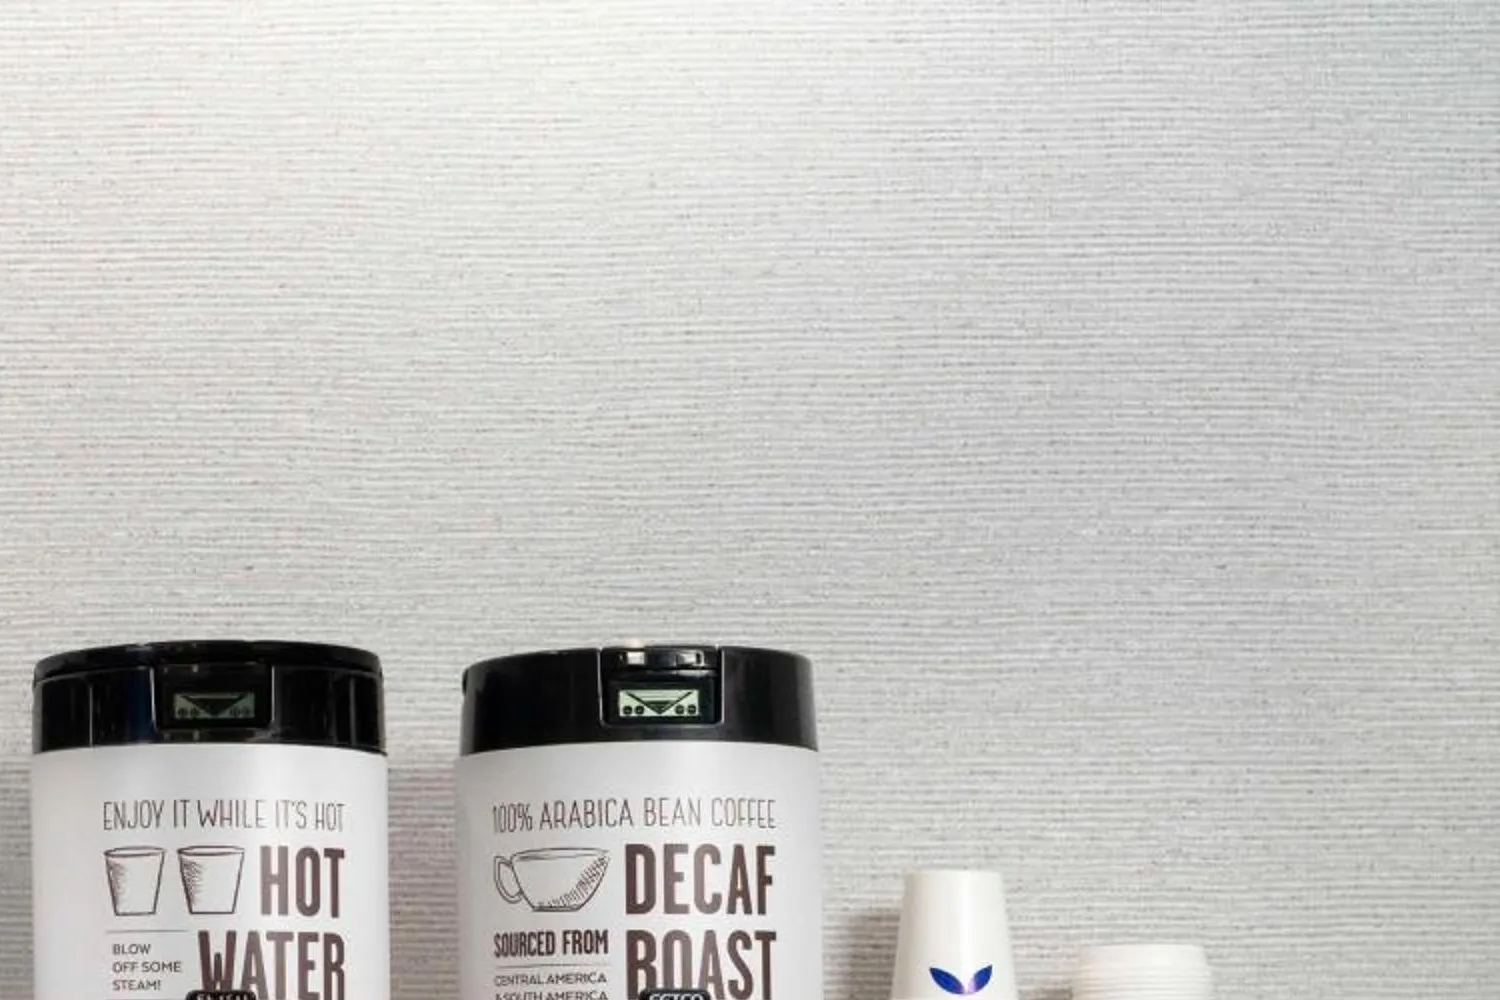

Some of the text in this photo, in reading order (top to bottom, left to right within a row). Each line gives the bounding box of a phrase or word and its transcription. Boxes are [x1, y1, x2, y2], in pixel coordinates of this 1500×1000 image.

[103, 800, 345, 831] ENJOY IT WHILE IT'S HOT
[493, 797, 776, 832] 100% ARABICA BEAN COFFEE
[260, 845, 345, 918] HOT
[625, 843, 775, 915] DECAF
[112, 944, 152, 955] BLOW
[494, 929, 608, 957] SOURCED FROM
[112, 961, 181, 973] OFF SOME
[494, 972, 607, 987] CENTRAL AMERICA
[626, 930, 776, 1000] ROAST
[112, 980, 161, 990] STEAM!
